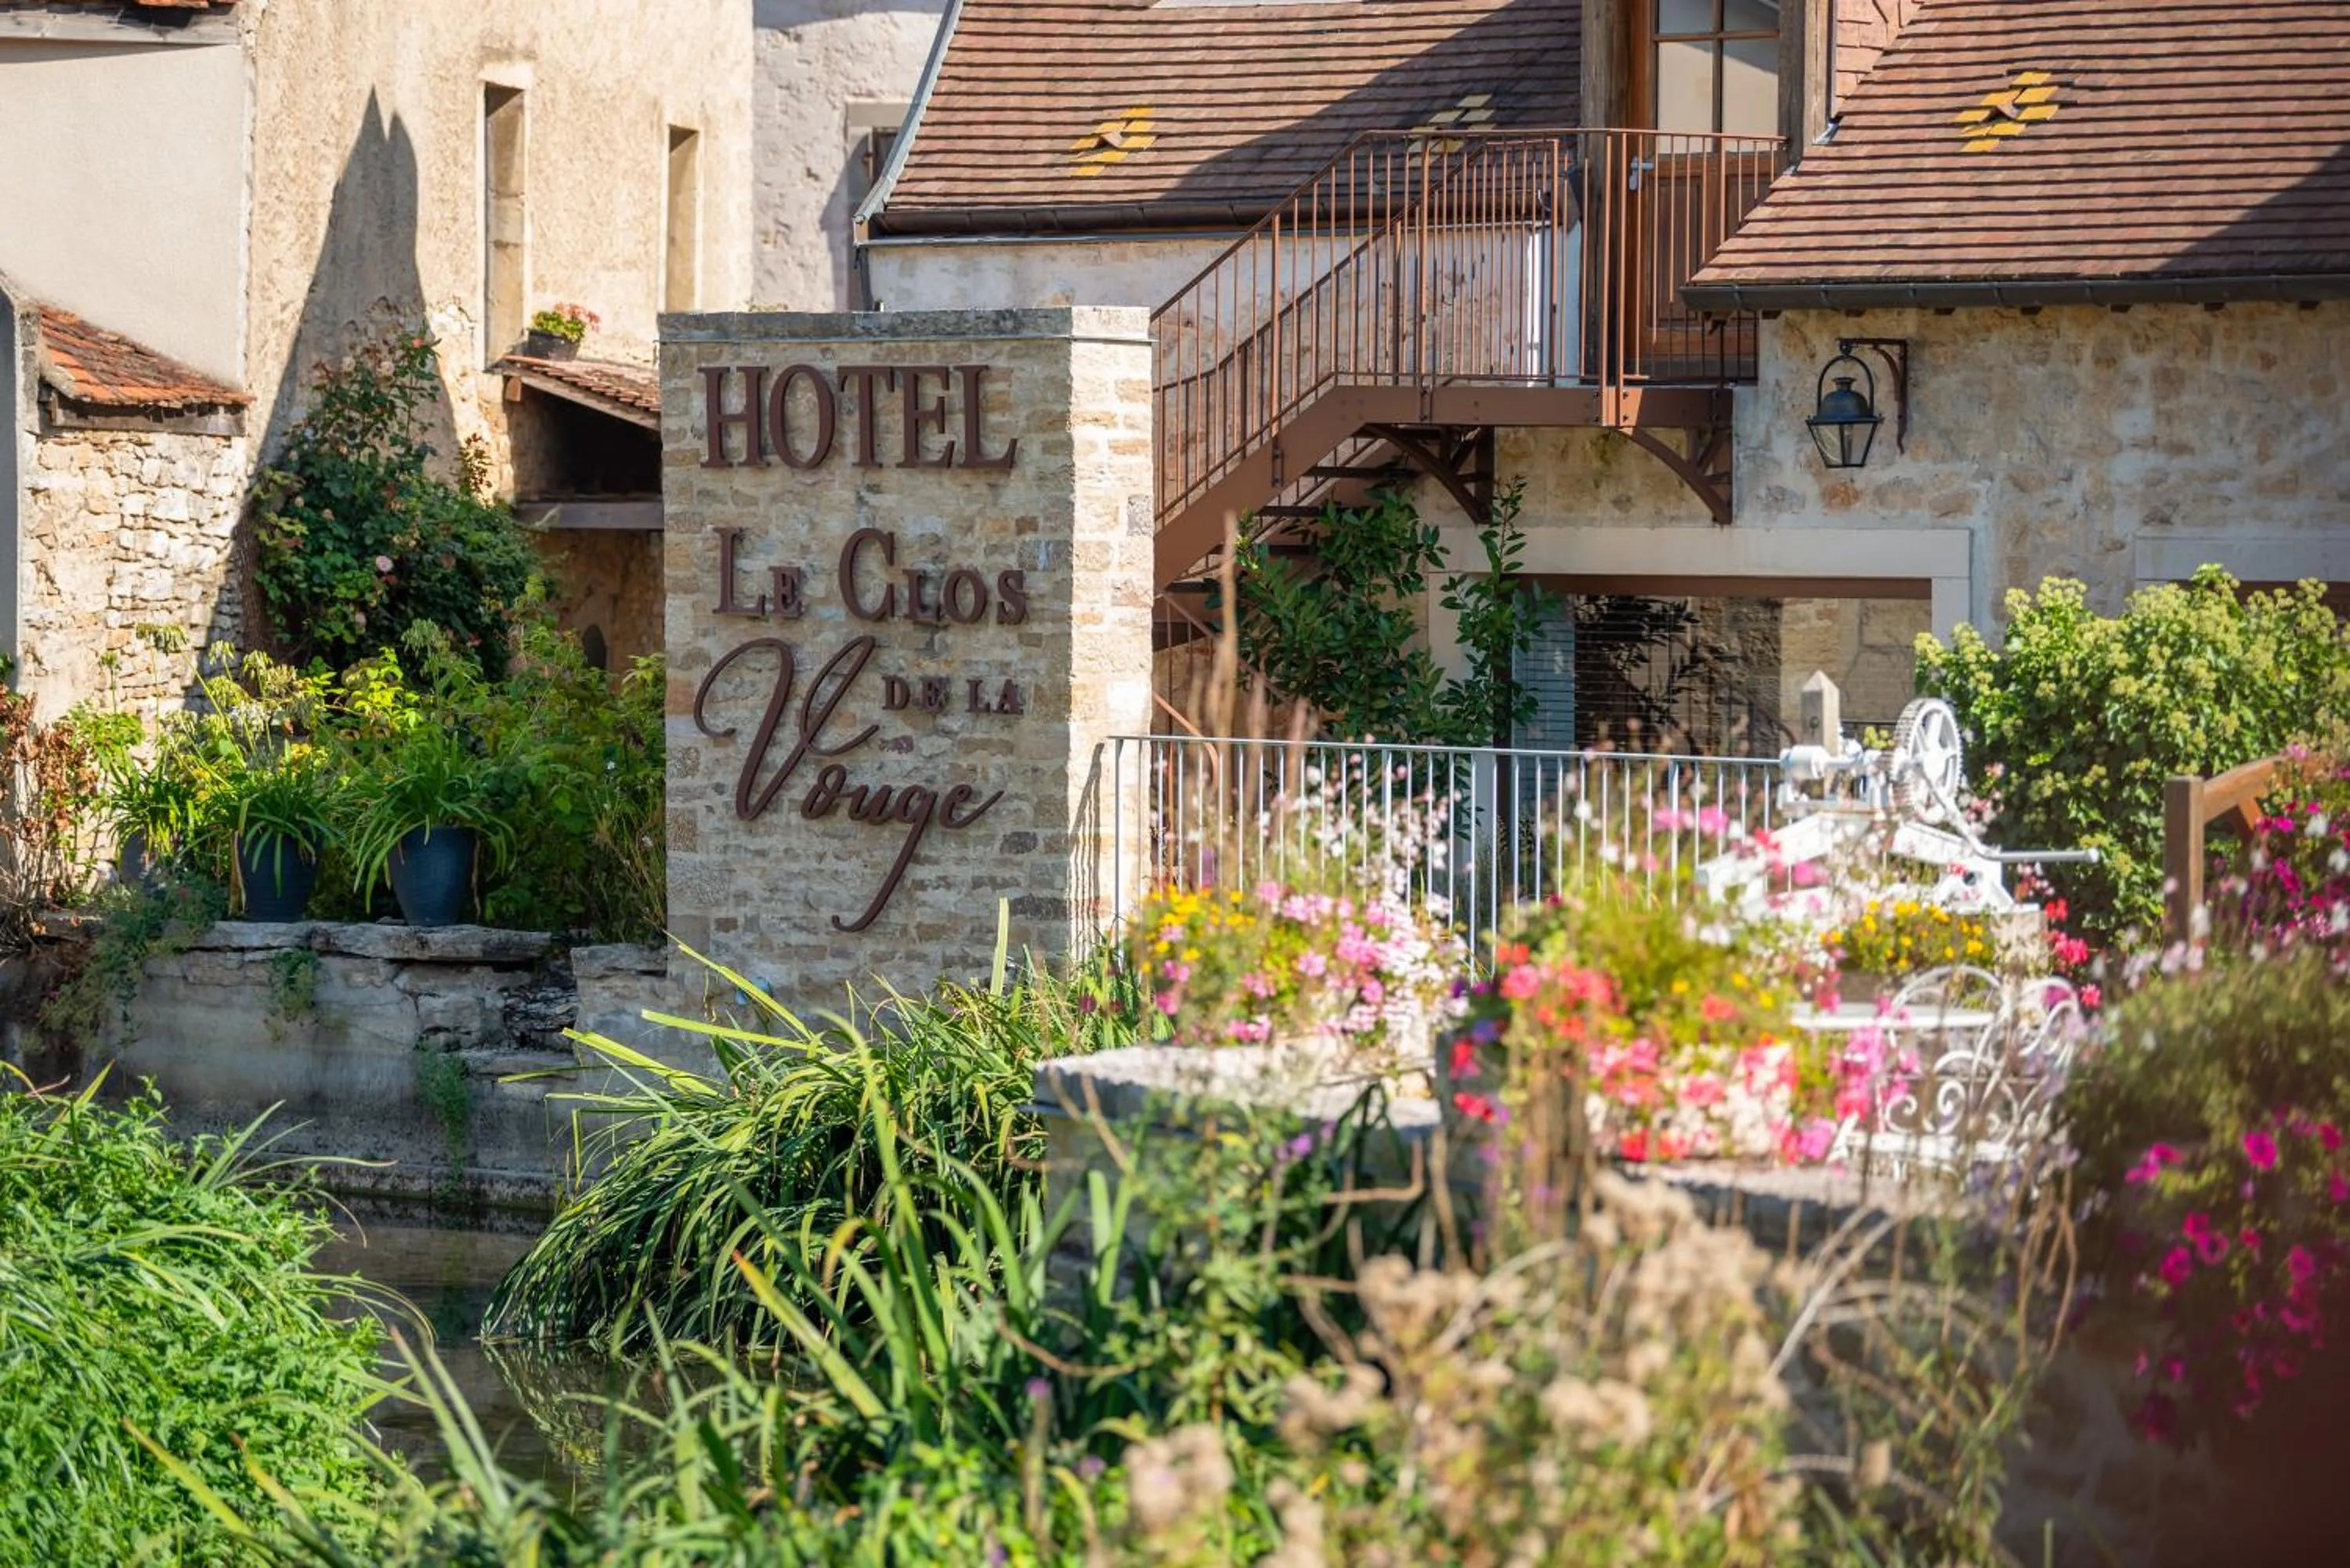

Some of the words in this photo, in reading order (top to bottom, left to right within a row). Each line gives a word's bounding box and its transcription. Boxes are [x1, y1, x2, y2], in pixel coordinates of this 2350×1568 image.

[697, 363, 1018, 470] HOTEL
[882, 675, 950, 714] DE
[965, 678, 1025, 716] LA
[693, 635, 1005, 933] Vouge
